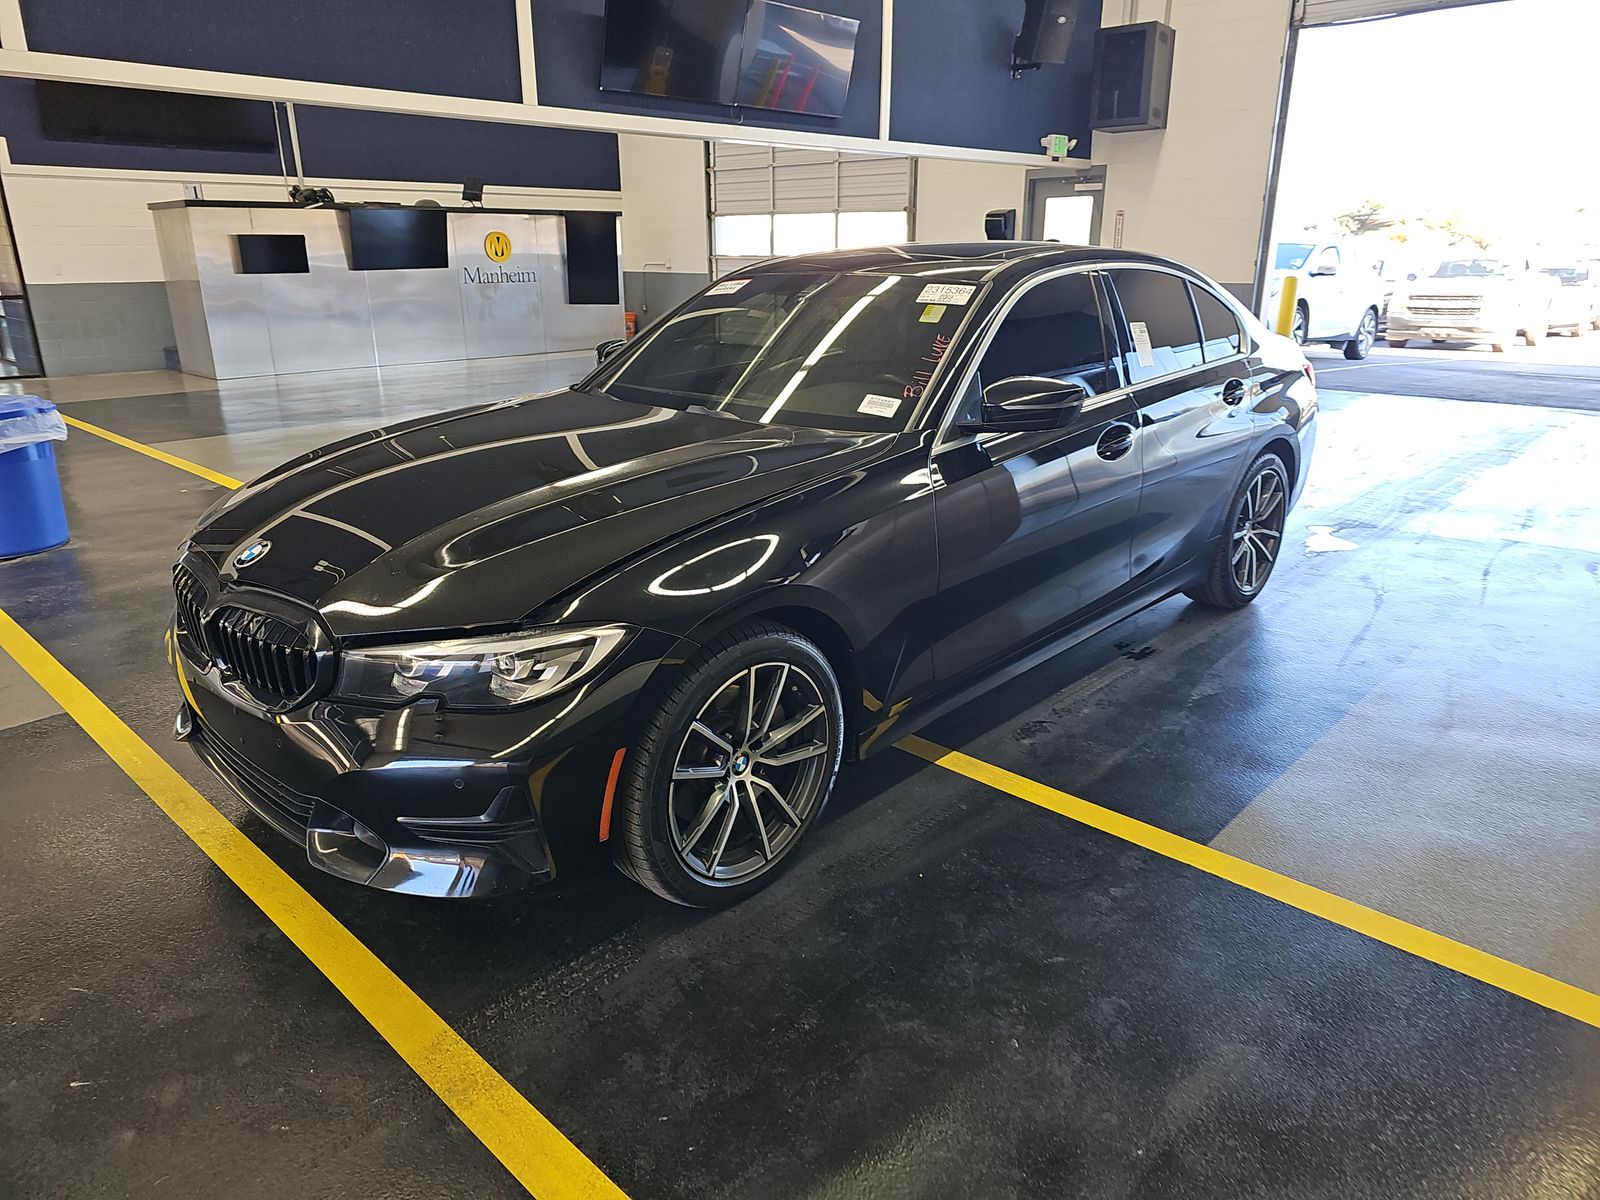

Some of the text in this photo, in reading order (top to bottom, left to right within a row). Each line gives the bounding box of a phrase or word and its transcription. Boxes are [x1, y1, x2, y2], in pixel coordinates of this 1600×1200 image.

[486, 233, 510, 260] M
[463, 265, 537, 285] Manheim
[924, 285, 974, 295] 2315364
